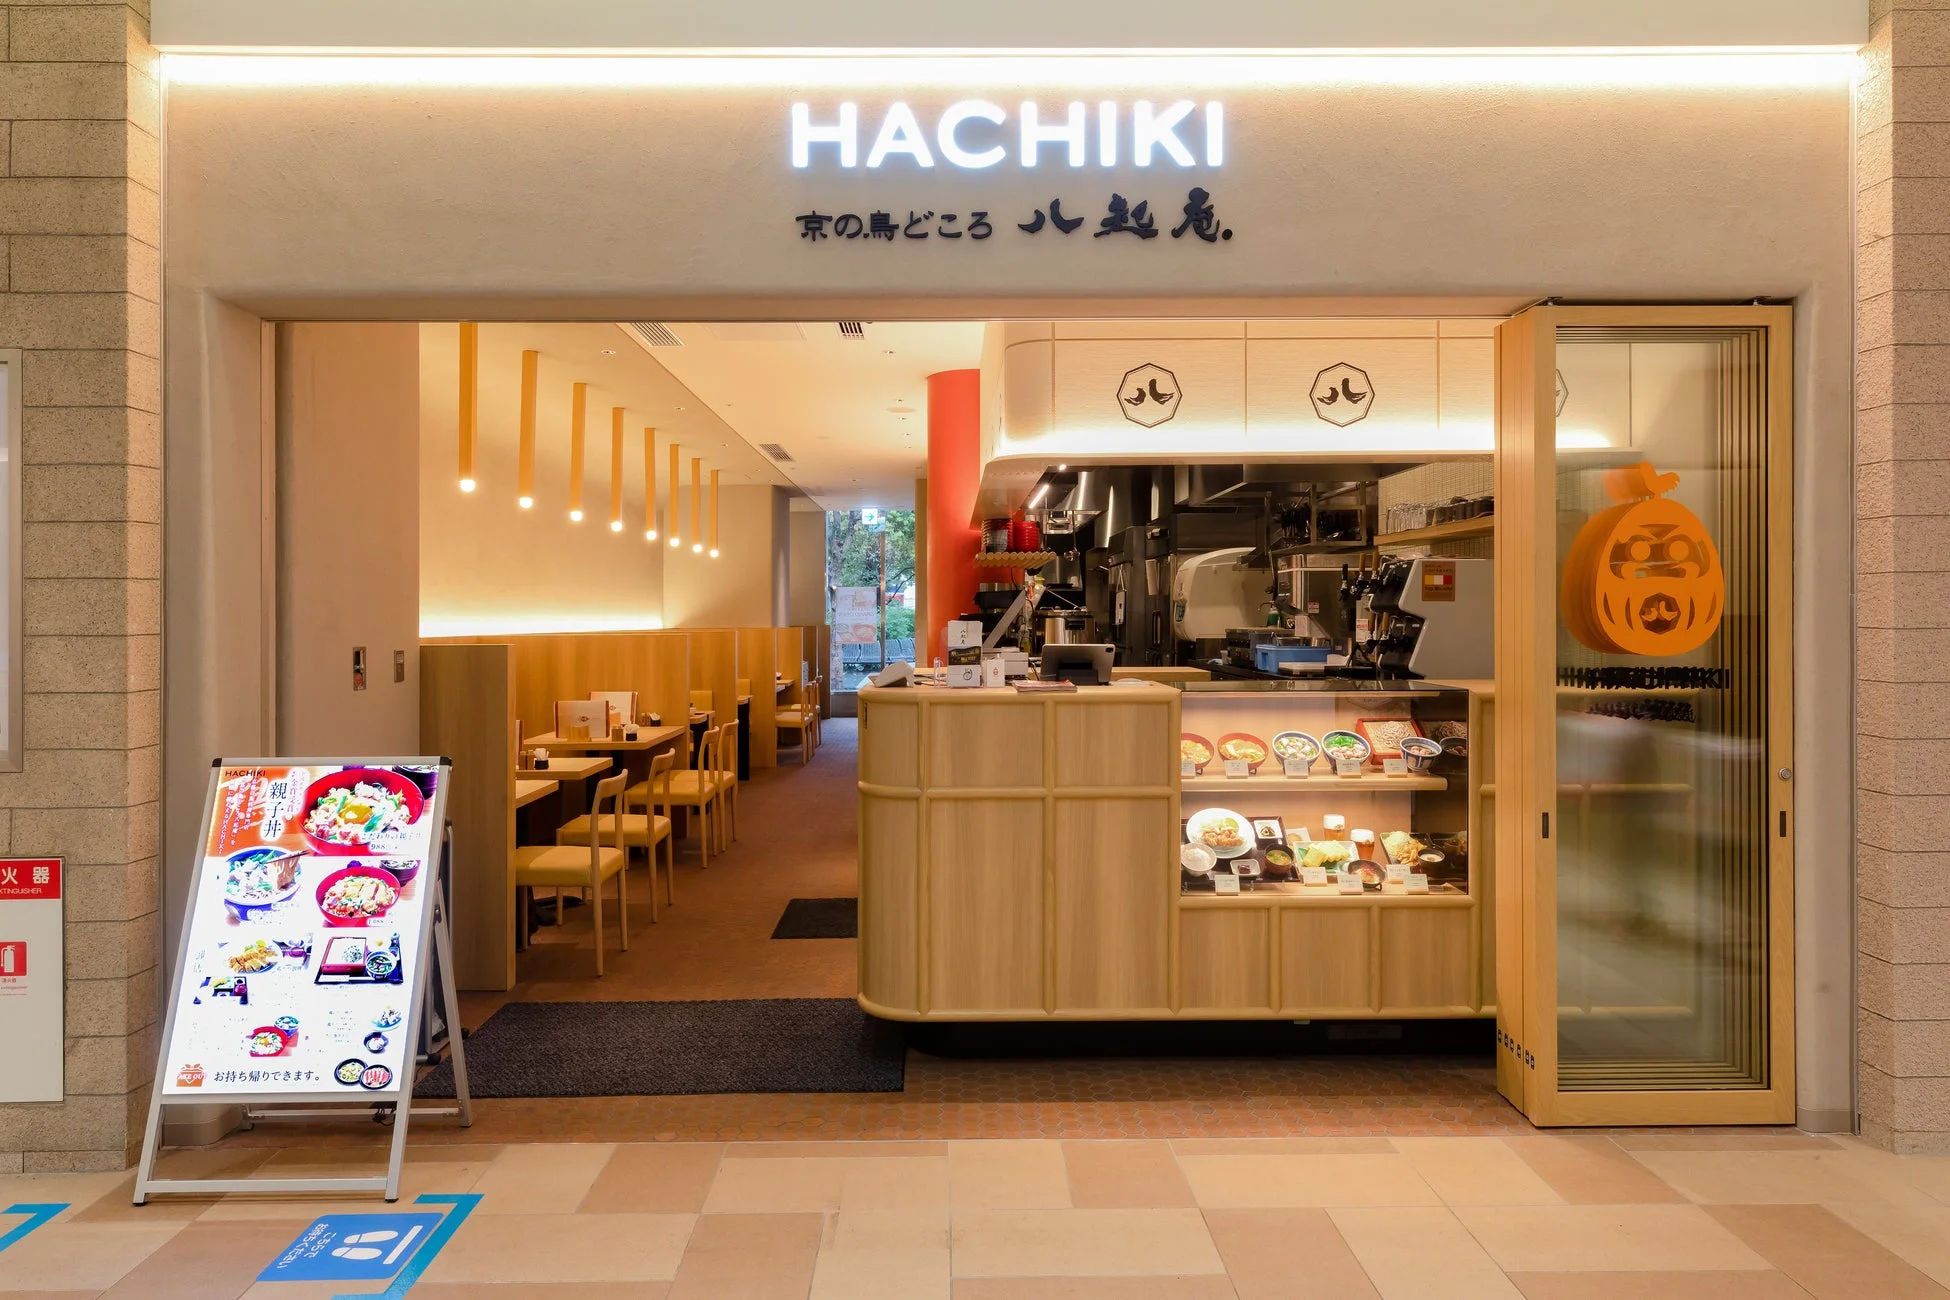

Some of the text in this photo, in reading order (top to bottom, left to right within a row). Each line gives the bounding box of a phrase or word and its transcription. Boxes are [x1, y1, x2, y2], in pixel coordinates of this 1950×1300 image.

[791, 100, 1224, 168] HACHIKI
[795, 209, 993, 241] 京の鳥どころ
[225, 769, 266, 777] HACHIKI
[264, 781, 288, 839] 親子丼
[213, 1069, 321, 1083] お持ち帰りできます。
[276, 1223, 329, 1269] お待ちください
[303, 1232, 337, 1259] こちらで
